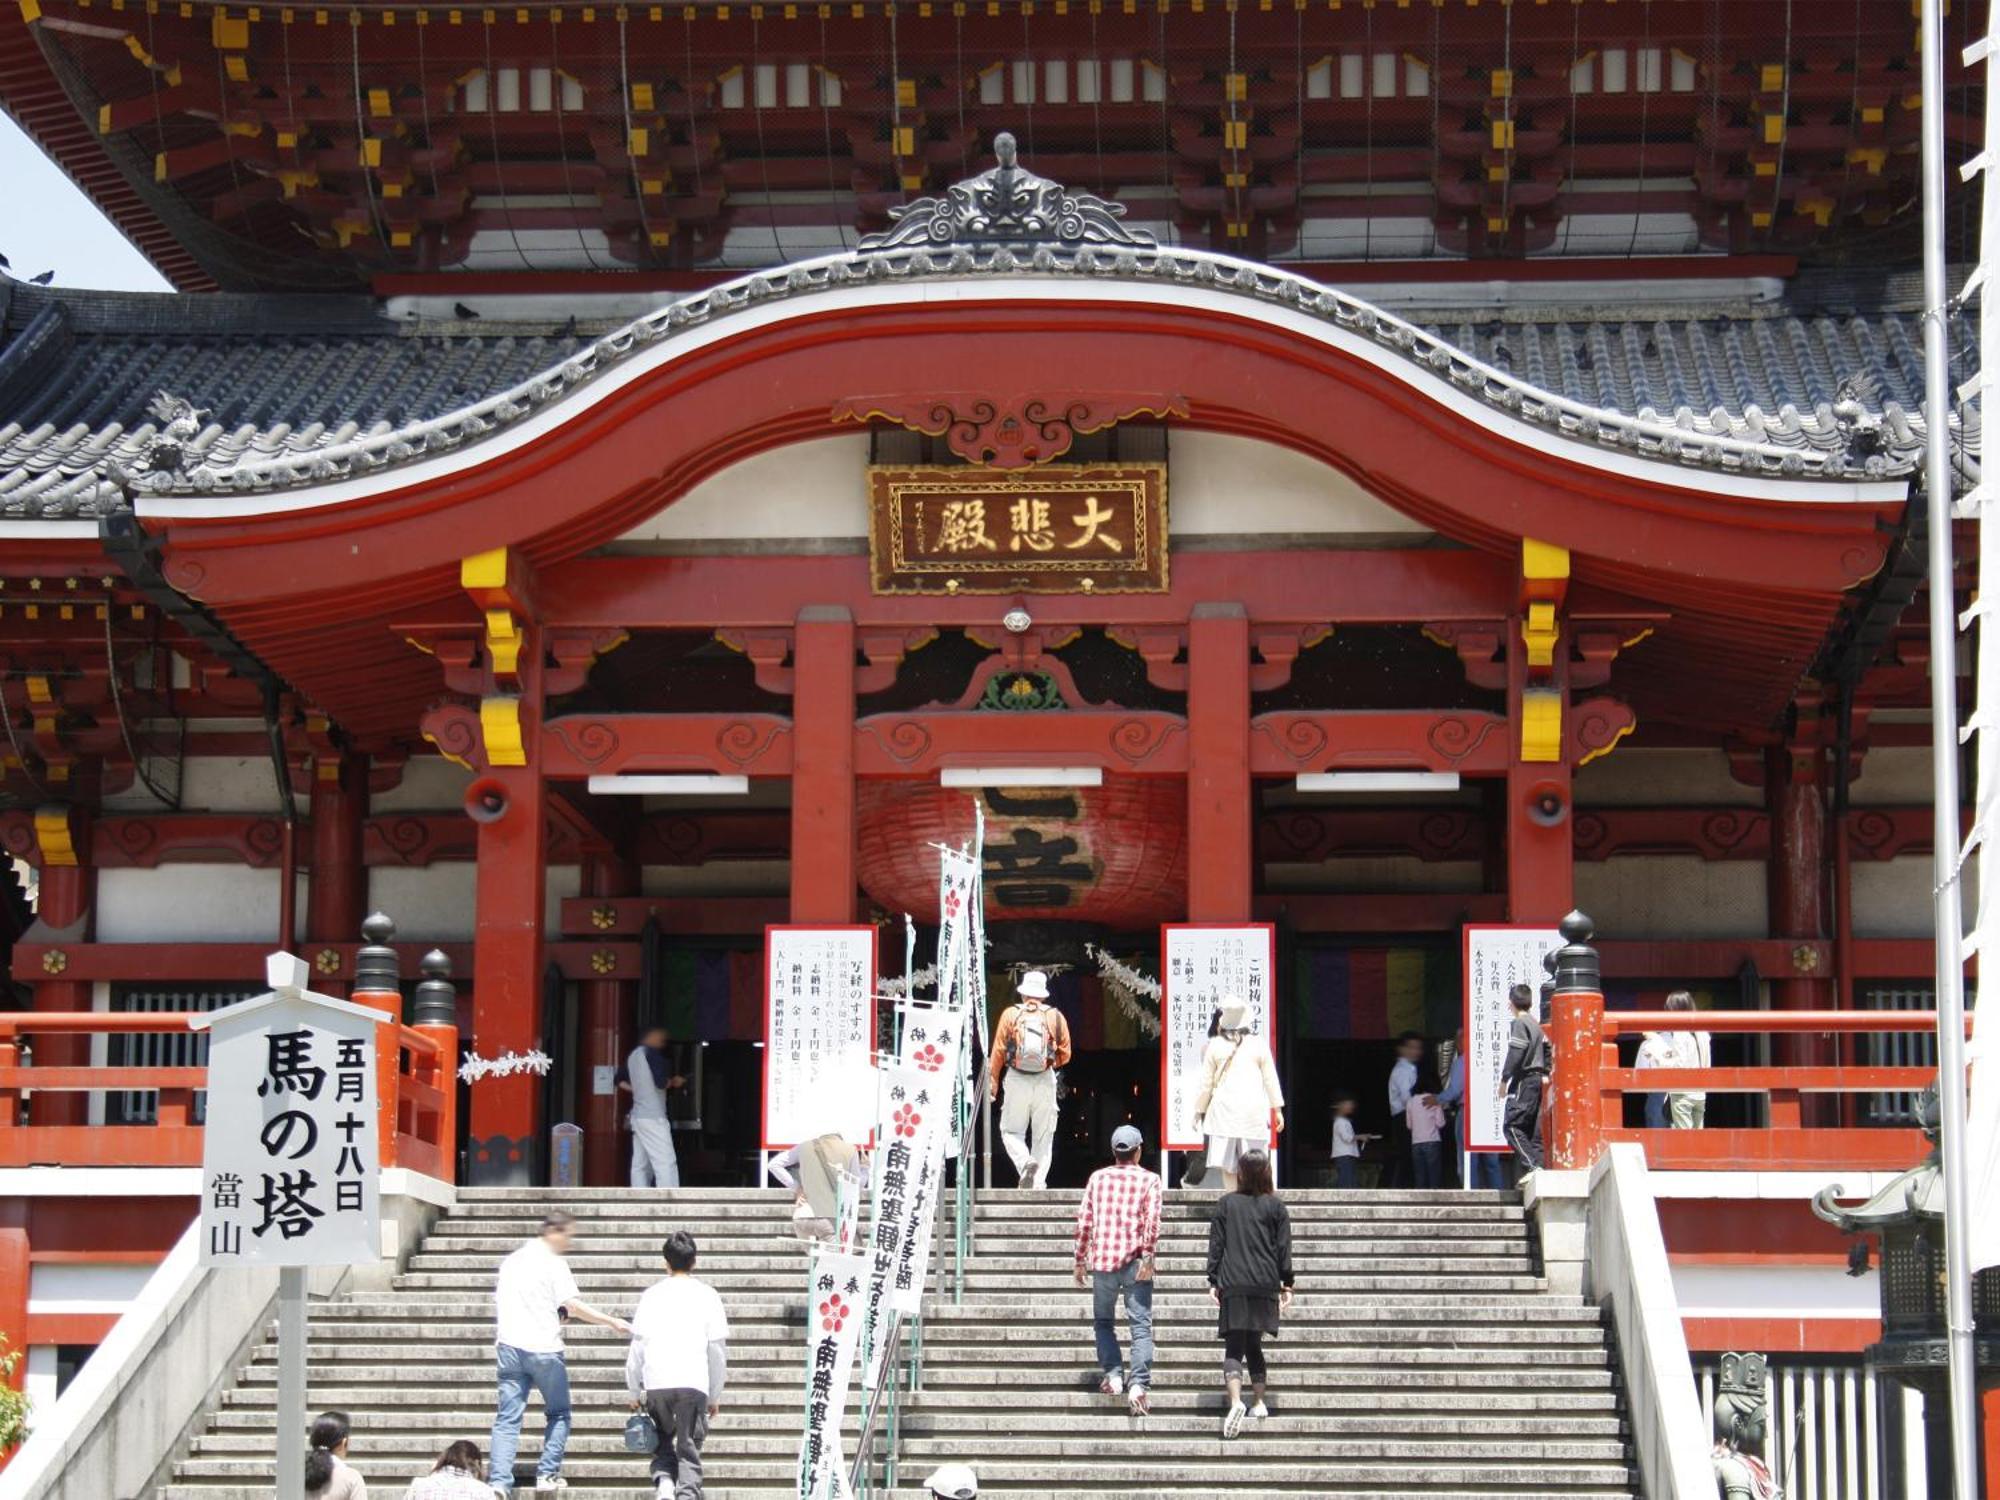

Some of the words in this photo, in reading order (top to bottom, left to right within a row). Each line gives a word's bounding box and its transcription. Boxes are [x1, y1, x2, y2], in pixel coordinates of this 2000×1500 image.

[931, 496, 1124, 554] 大悲殿
[849, 959, 863, 1042] 写経のすすめ
[252, 1029, 328, 1241] 馬の塔
[335, 1038, 366, 1212] 五月十八日
[210, 1172, 244, 1257] 當山
